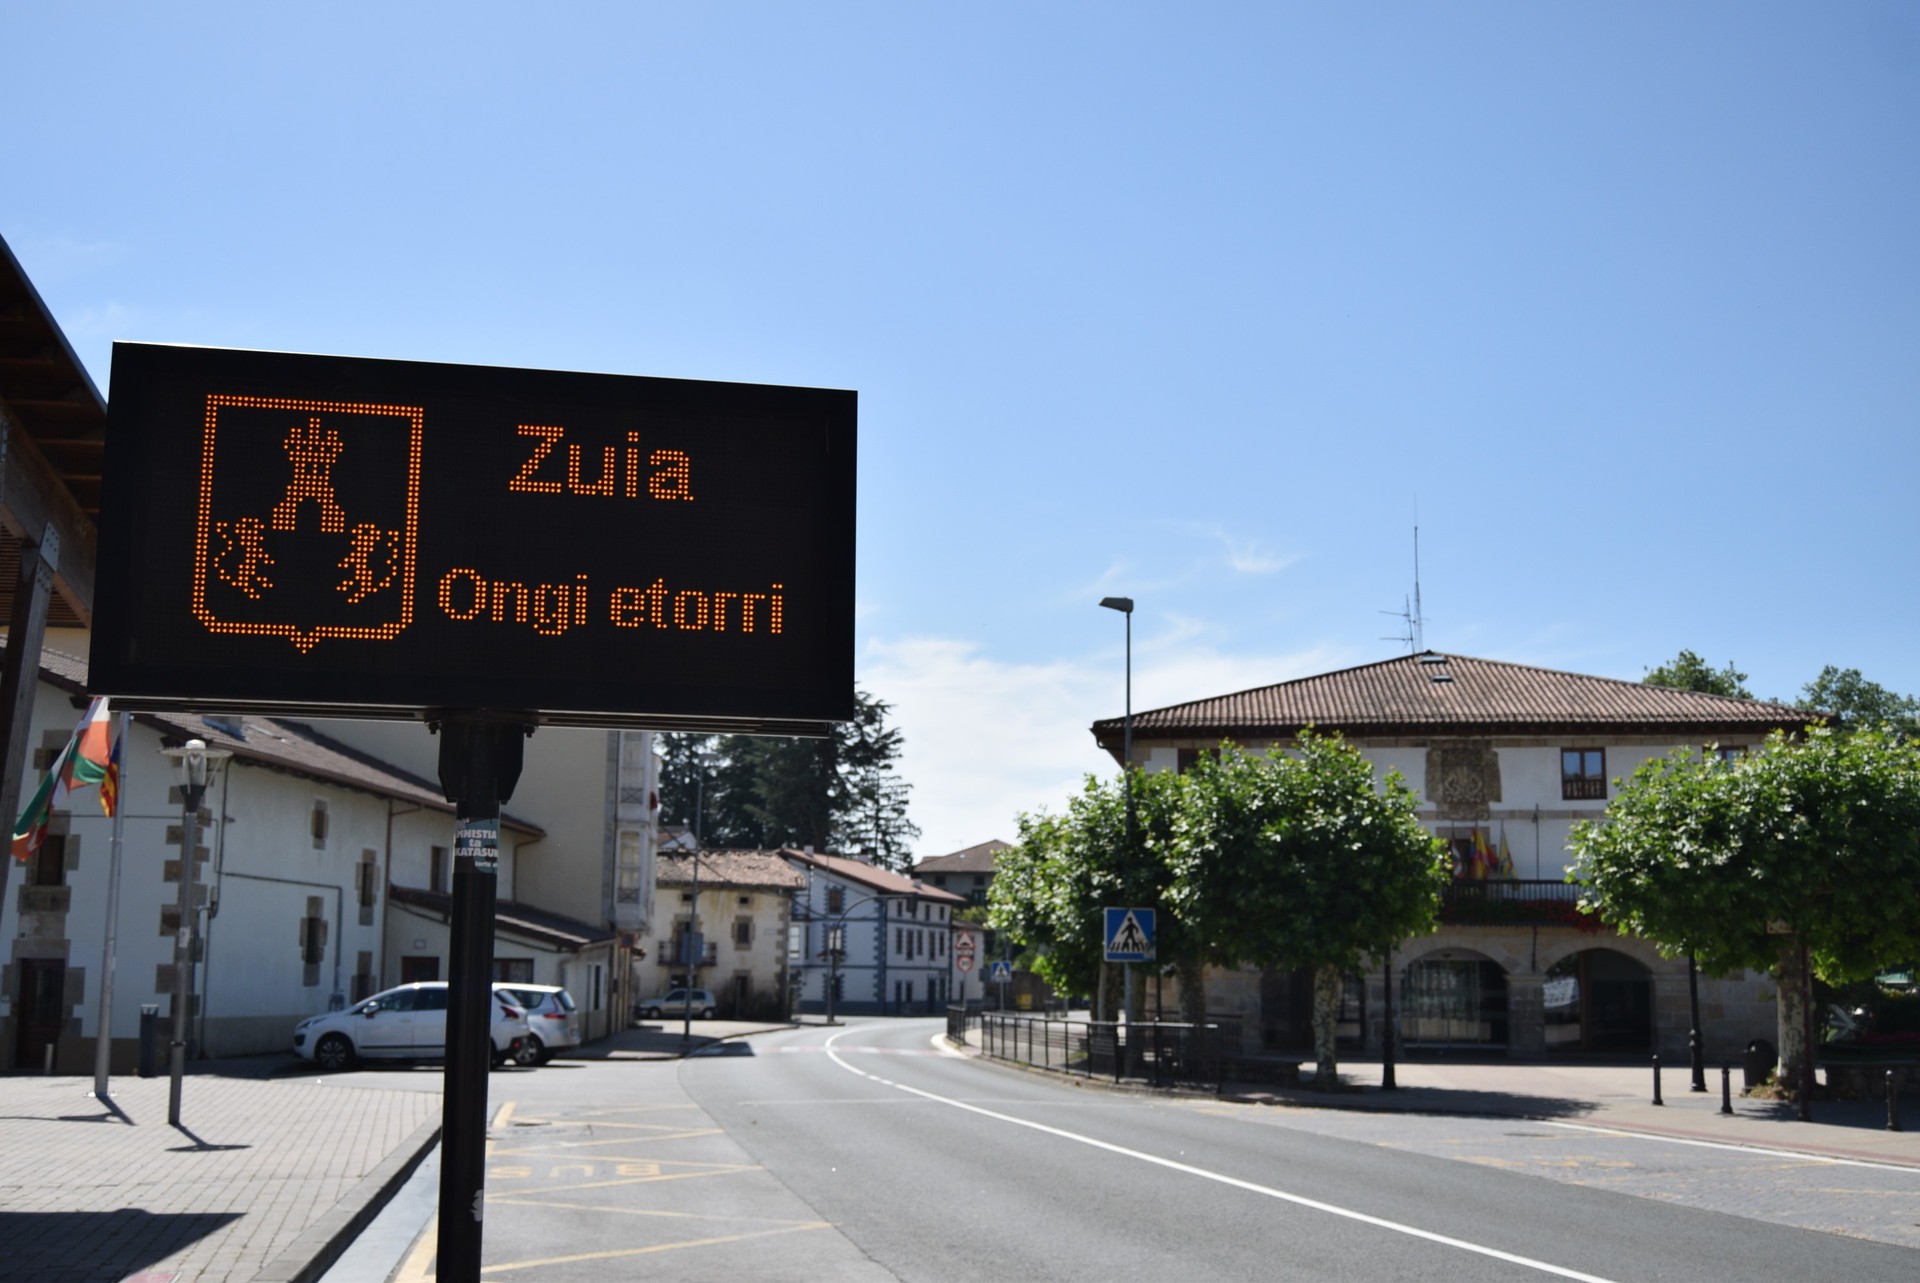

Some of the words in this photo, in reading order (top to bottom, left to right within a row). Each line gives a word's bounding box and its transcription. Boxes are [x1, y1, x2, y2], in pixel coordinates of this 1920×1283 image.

[508, 424, 695, 501] Zuia
[438, 567, 588, 636] Ongi
[610, 577, 783, 635] etorri
[469, 839, 481, 847] ta
[489, 1164, 660, 1179] BUS
